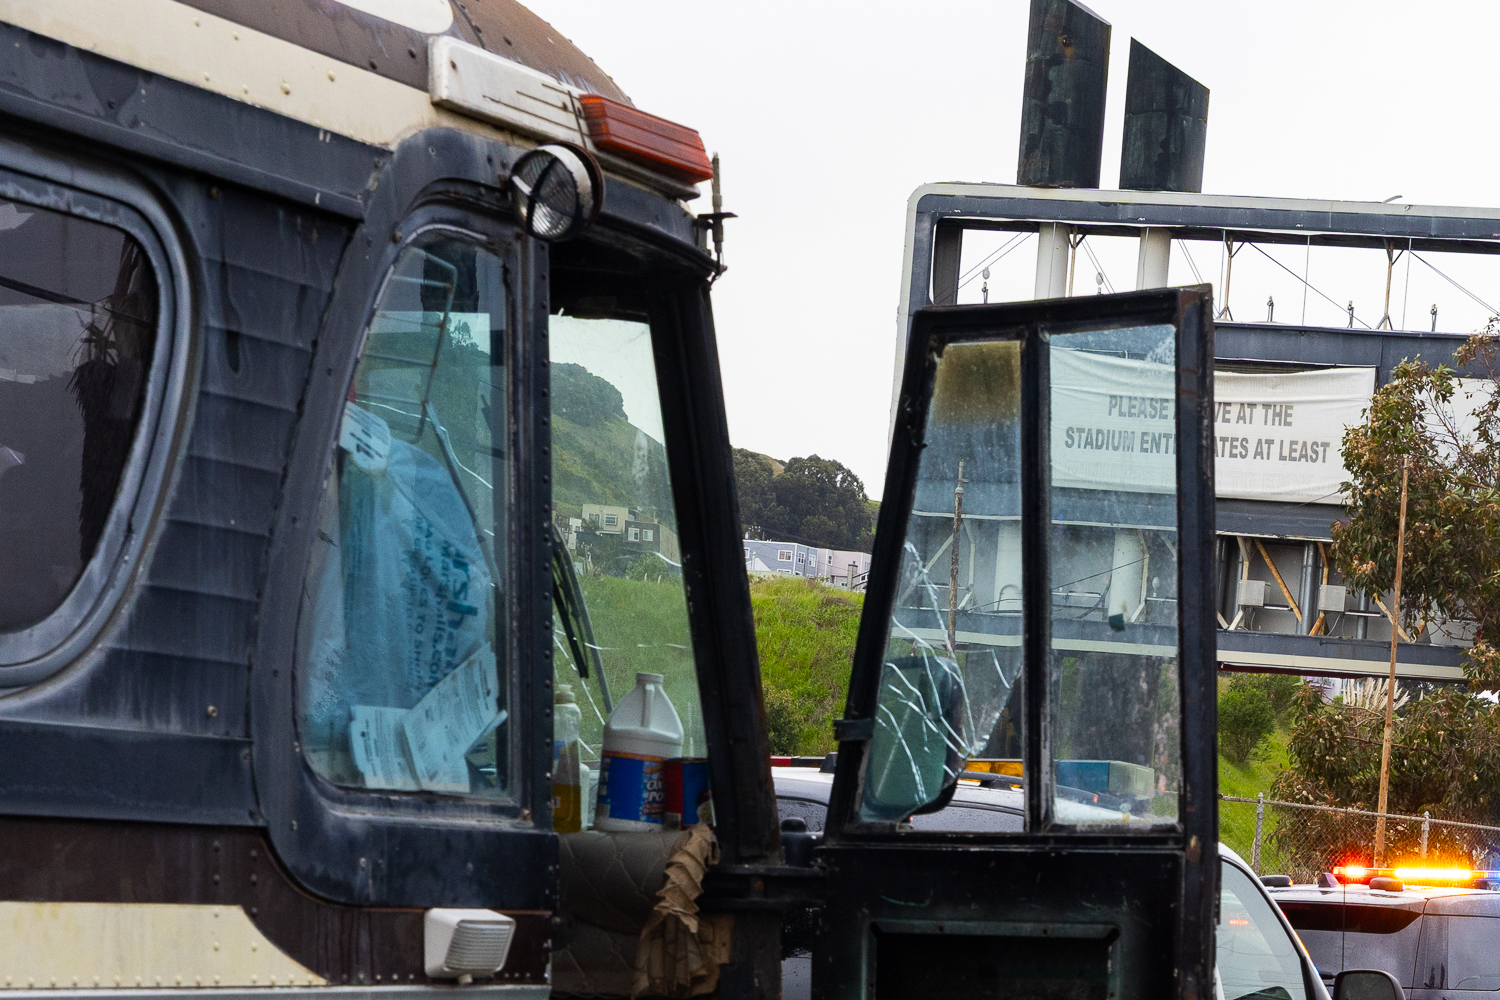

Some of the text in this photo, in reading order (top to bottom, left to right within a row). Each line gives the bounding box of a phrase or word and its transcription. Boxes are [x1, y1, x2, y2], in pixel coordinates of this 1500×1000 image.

[1108, 395, 1170, 420] PLEASE
[1236, 403, 1258, 425] AT
[1262, 404, 1294, 428] THE
[1064, 427, 1136, 454] STADIUM
[1253, 438, 1275, 462] AT
[1278, 439, 1331, 464] LEAST
